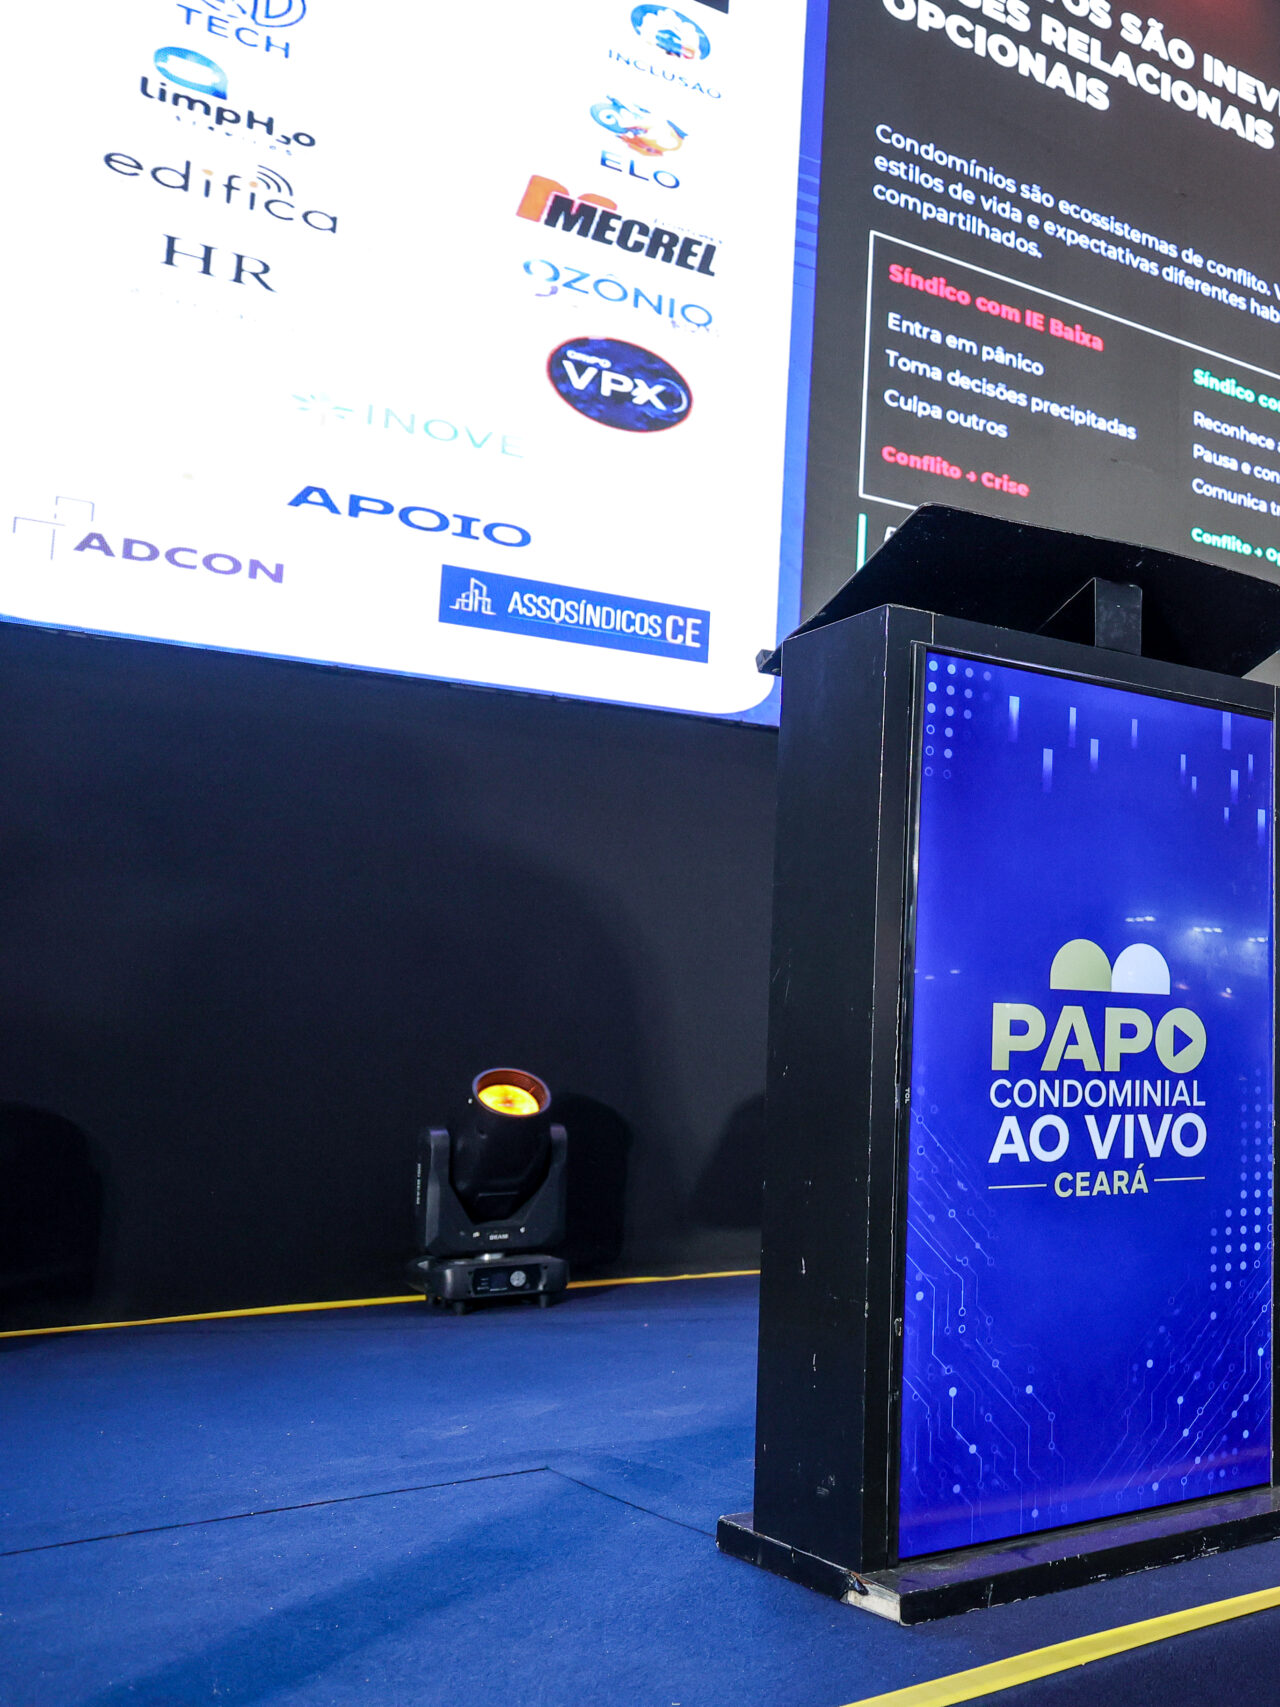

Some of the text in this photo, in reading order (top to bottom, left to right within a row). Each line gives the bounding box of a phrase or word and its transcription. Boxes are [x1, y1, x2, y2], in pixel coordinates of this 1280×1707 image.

[176, 3, 290, 59] TECH
[883, 0, 1110, 111] OPCIONAIS
[1120, 12, 1195, 70] SÃO
[1041, 13, 1275, 150] RELACIONAIS
[103, 152, 338, 234] edifica
[600, 150, 680, 189] ELO
[544, 194, 717, 277] MECREL
[873, 184, 1043, 259] compartilhados.
[874, 155, 945, 194] estilos
[948, 182, 976, 205] de
[980, 194, 1023, 223] vida
[1027, 213, 1041, 230] e
[1043, 220, 1160, 276] expectativas
[1162, 265, 1248, 311] diferentes
[875, 124, 1017, 194] Condomínios
[1020, 184, 1055, 208] são
[1058, 199, 1178, 258] ecossistemas
[1181, 248, 1204, 268] de
[1206, 259, 1271, 295] conflito.
[160, 233, 278, 293] HR
[888, 263, 1105, 352] Síndico com IE Baixa
[887, 312, 1045, 377] Entra em pânico
[562, 359, 667, 411] VPX
[885, 348, 1138, 441] Toma decisões precipitadas
[1192, 367, 1256, 403] Síndico
[366, 403, 525, 458] INOVE
[883, 388, 1009, 439] Culpa outros
[1192, 410, 1276, 451] Reconhece
[881, 445, 1031, 498] Conflito Crise
[1192, 443, 1239, 472] Pausa
[1240, 459, 1252, 475] e
[287, 485, 531, 547] APOIO
[1192, 478, 1268, 514] Comunica
[73, 532, 285, 584] ADCON
[1190, 527, 1253, 557] Conflito
[665, 614, 702, 648] CE
[991, 1002, 1207, 1074] PAPO
[989, 1078, 1206, 1109] CONDOMINIAL
[987, 1112, 1207, 1163] AO VIVO
[1053, 1163, 1149, 1198] CEARÁ
